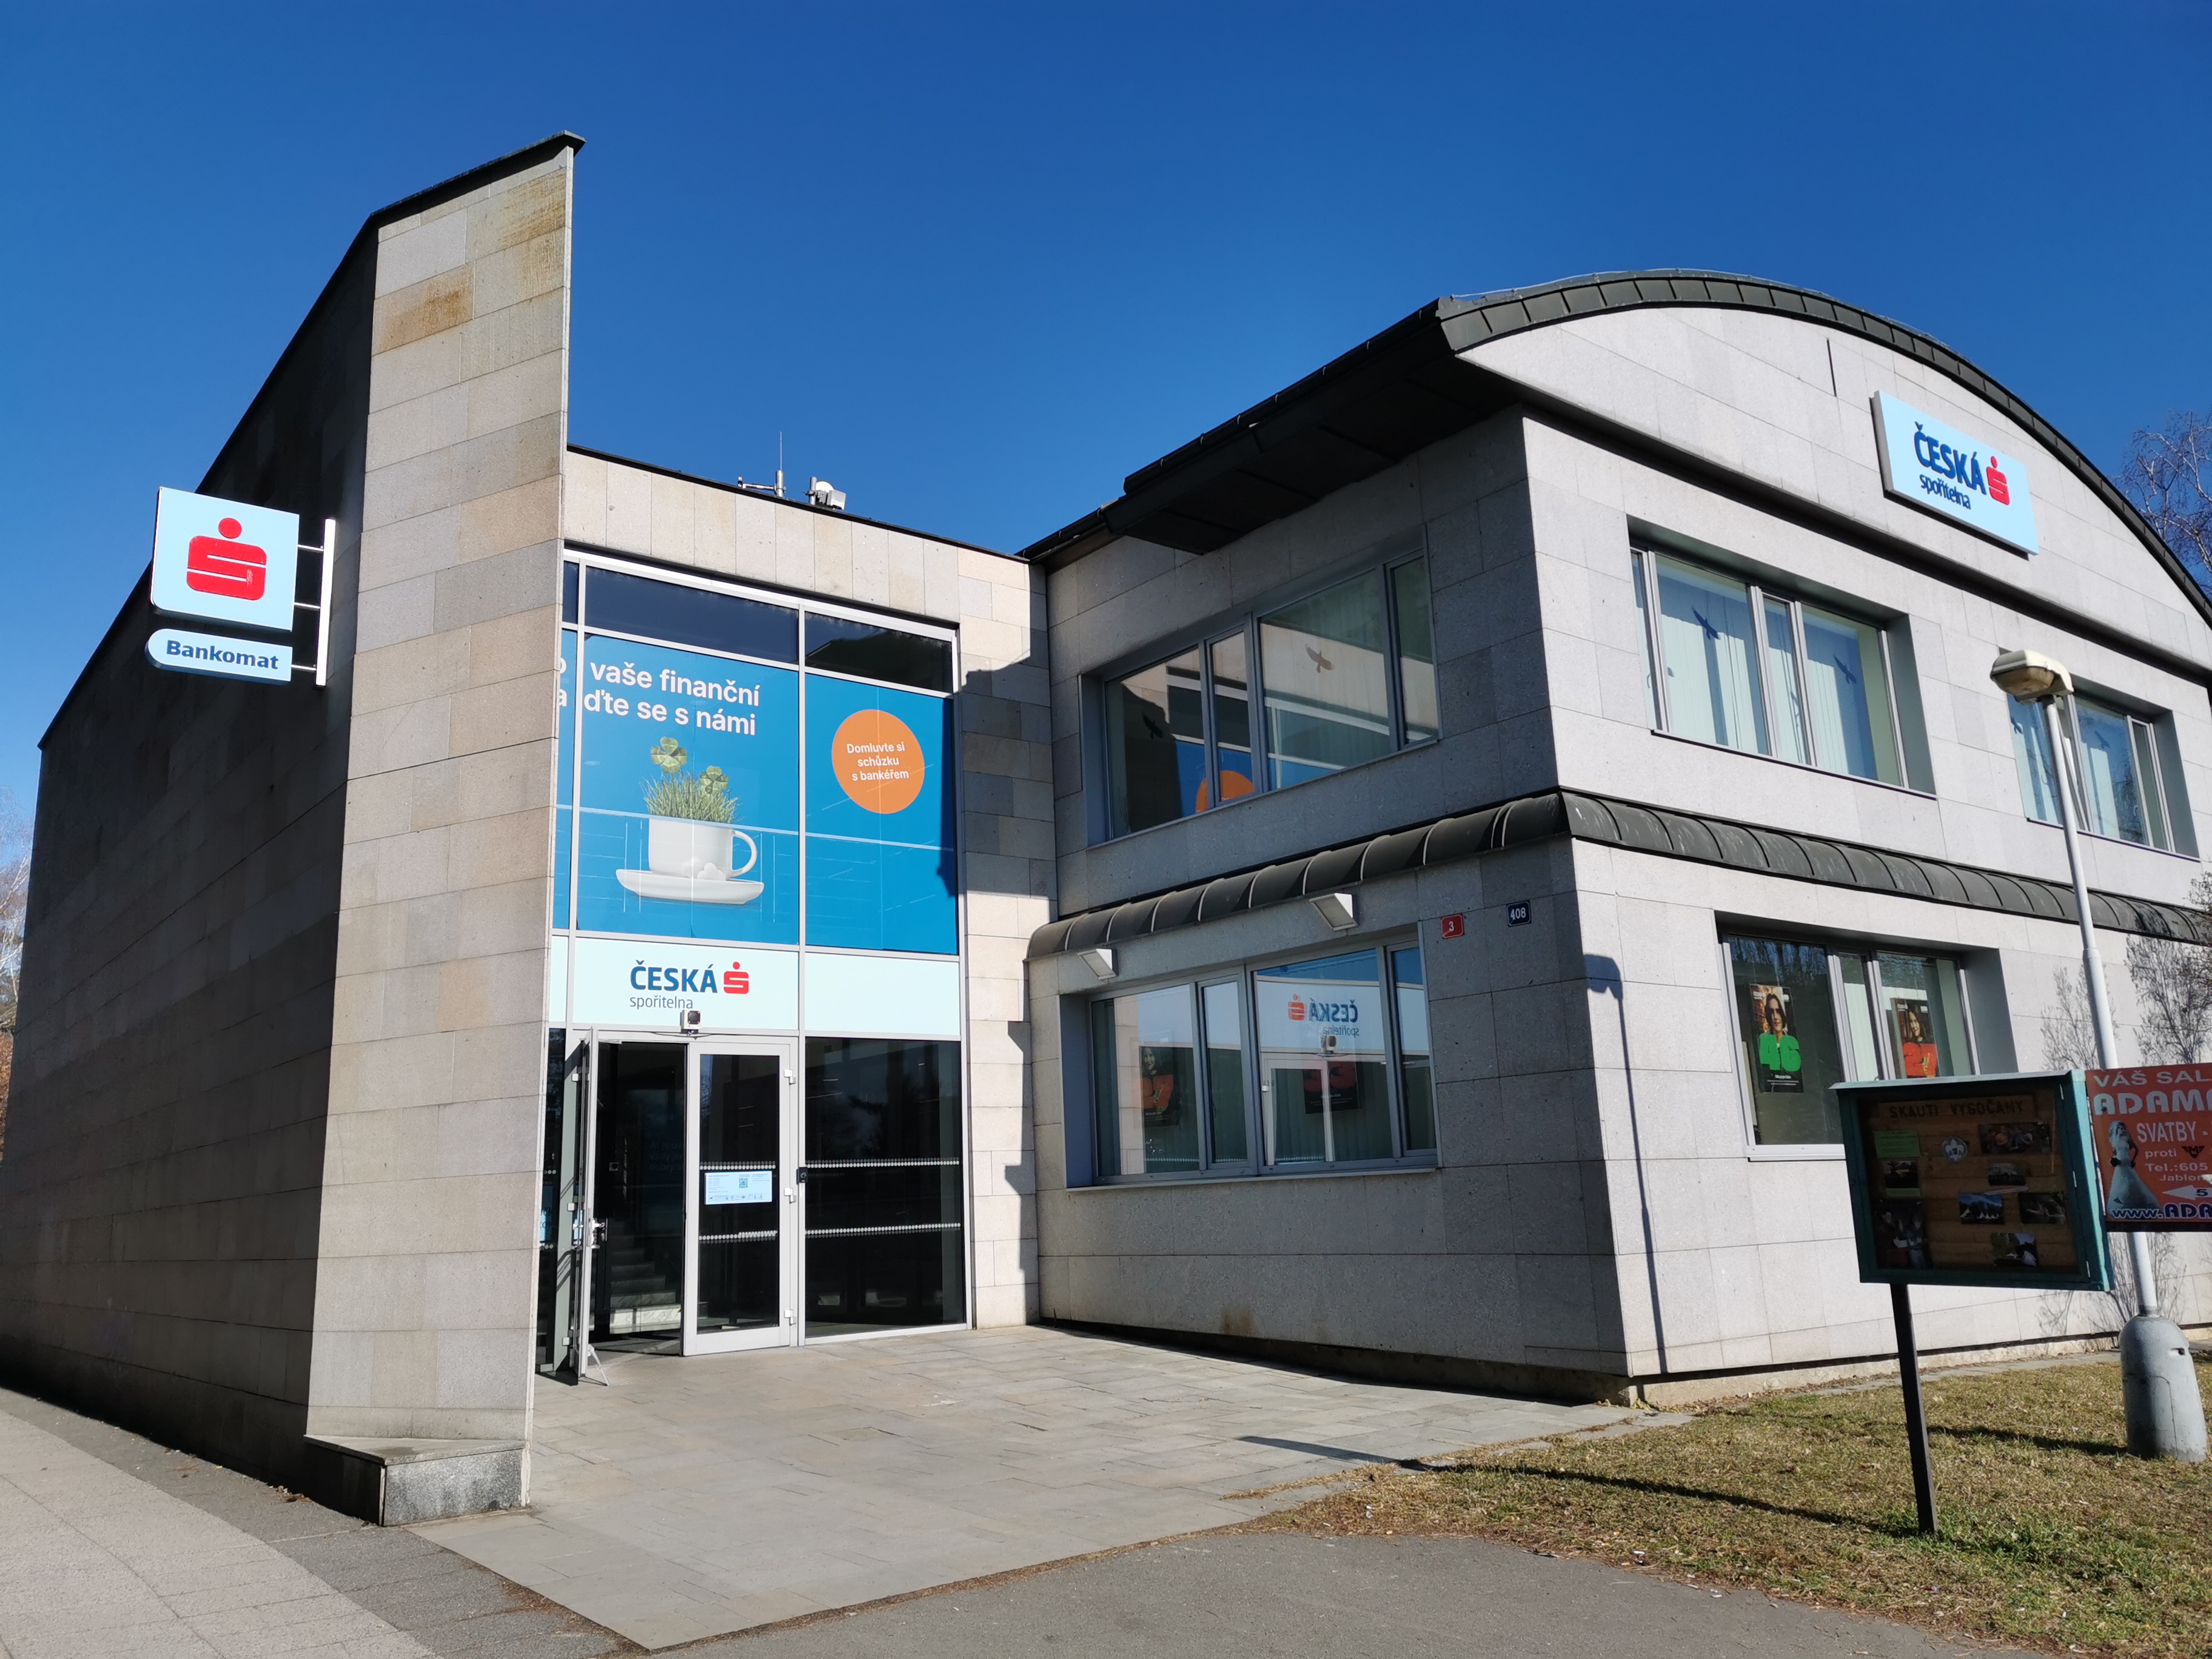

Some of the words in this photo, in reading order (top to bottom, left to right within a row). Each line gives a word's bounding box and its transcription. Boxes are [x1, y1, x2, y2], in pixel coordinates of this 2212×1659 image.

[1914, 421, 1987, 495] ČESKÁ
[1920, 474, 1971, 509] spořitelna
[166, 640, 278, 669] Bankomat
[590, 662, 652, 688] vaše
[660, 669, 760, 706] finanční
[637, 702, 667, 722] se
[675, 708, 689, 725] s
[697, 709, 756, 736] námi
[846, 743, 894, 754] Domluvte
[896, 742, 905, 752] si
[857, 755, 899, 767] schůzku
[852, 773, 858, 781] s
[860, 769, 909, 781] bankéřem
[1510, 907, 1526, 920] 408
[1449, 921, 1454, 931] 3
[630, 959, 718, 993] ČESKÁ
[629, 995, 693, 1010] spořitelna
[1759, 1033, 1801, 1071] 46
[2093, 1070, 2147, 1087] VÁŠ
[2156, 1070, 2212, 1084] SAL
[1889, 1104, 1939, 1118] SKAUTI
[1949, 1099, 2023, 1116] VYSOČANY
[2093, 1089, 2212, 1116] ADAM
[2137, 1121, 2196, 1143] SVATBY
[2145, 1148, 2177, 1159] proti
